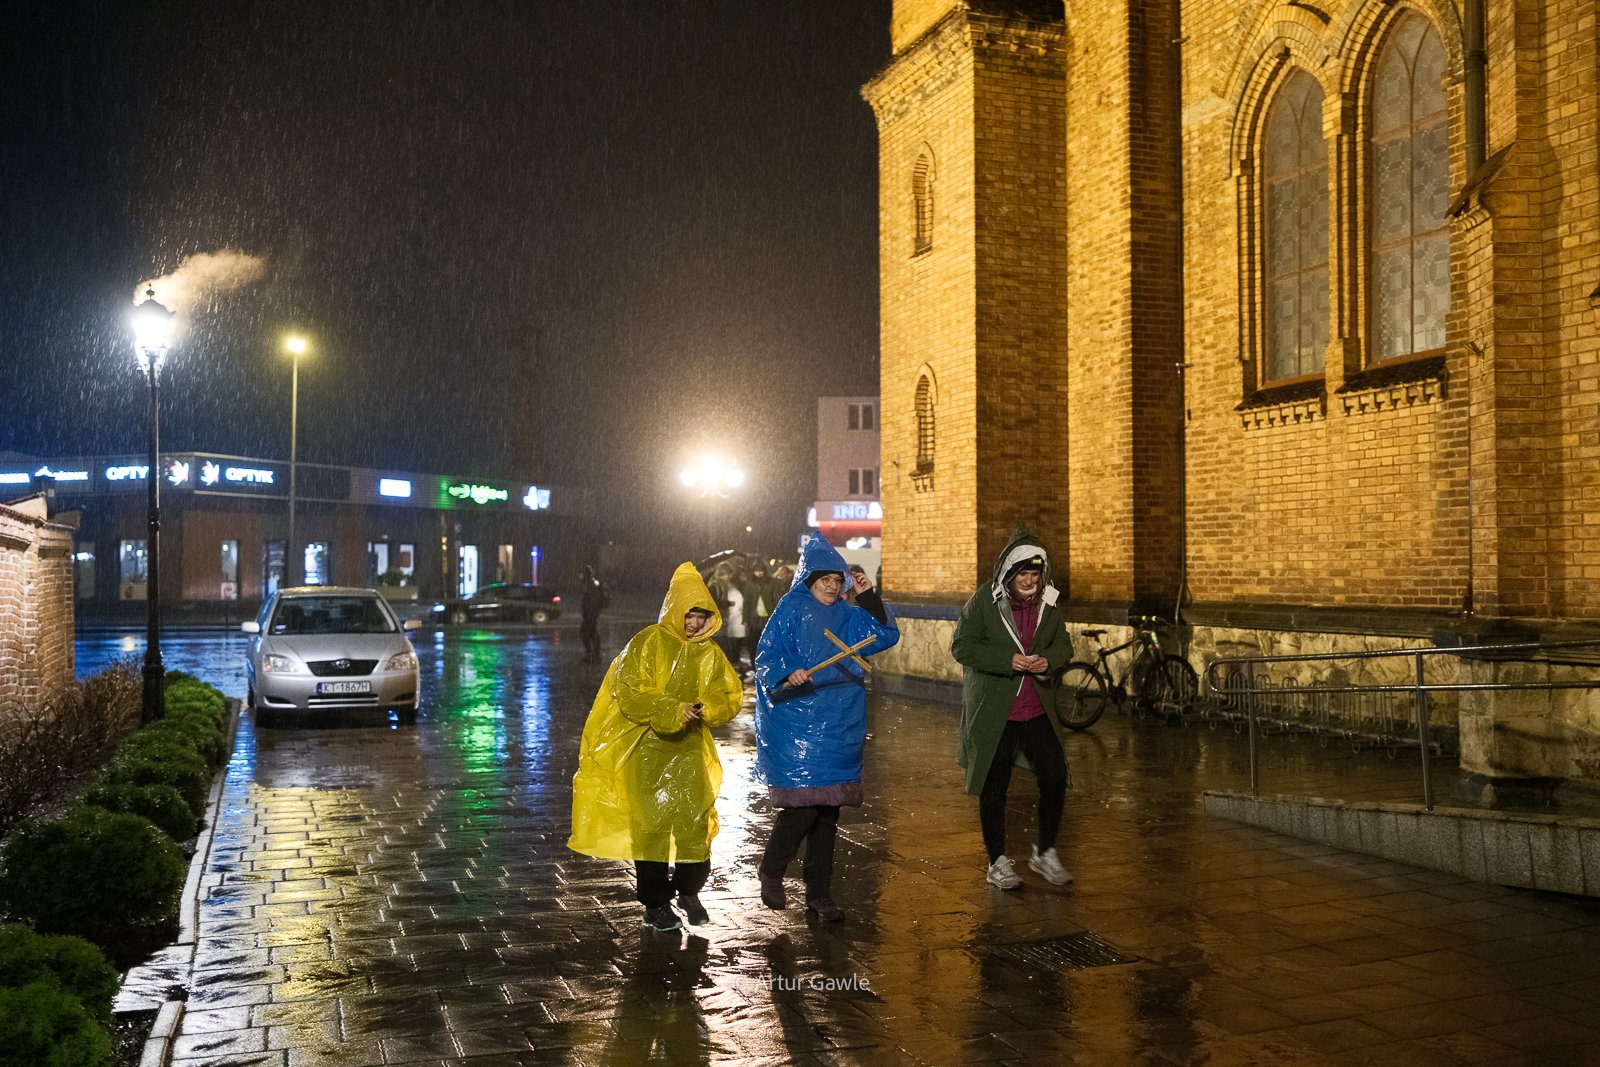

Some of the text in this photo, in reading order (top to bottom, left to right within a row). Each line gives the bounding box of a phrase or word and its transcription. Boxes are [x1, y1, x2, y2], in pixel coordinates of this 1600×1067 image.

[106, 465, 152, 480] OPTY
[225, 467, 274, 483] OPTYK
[832, 504, 867, 519] ING
